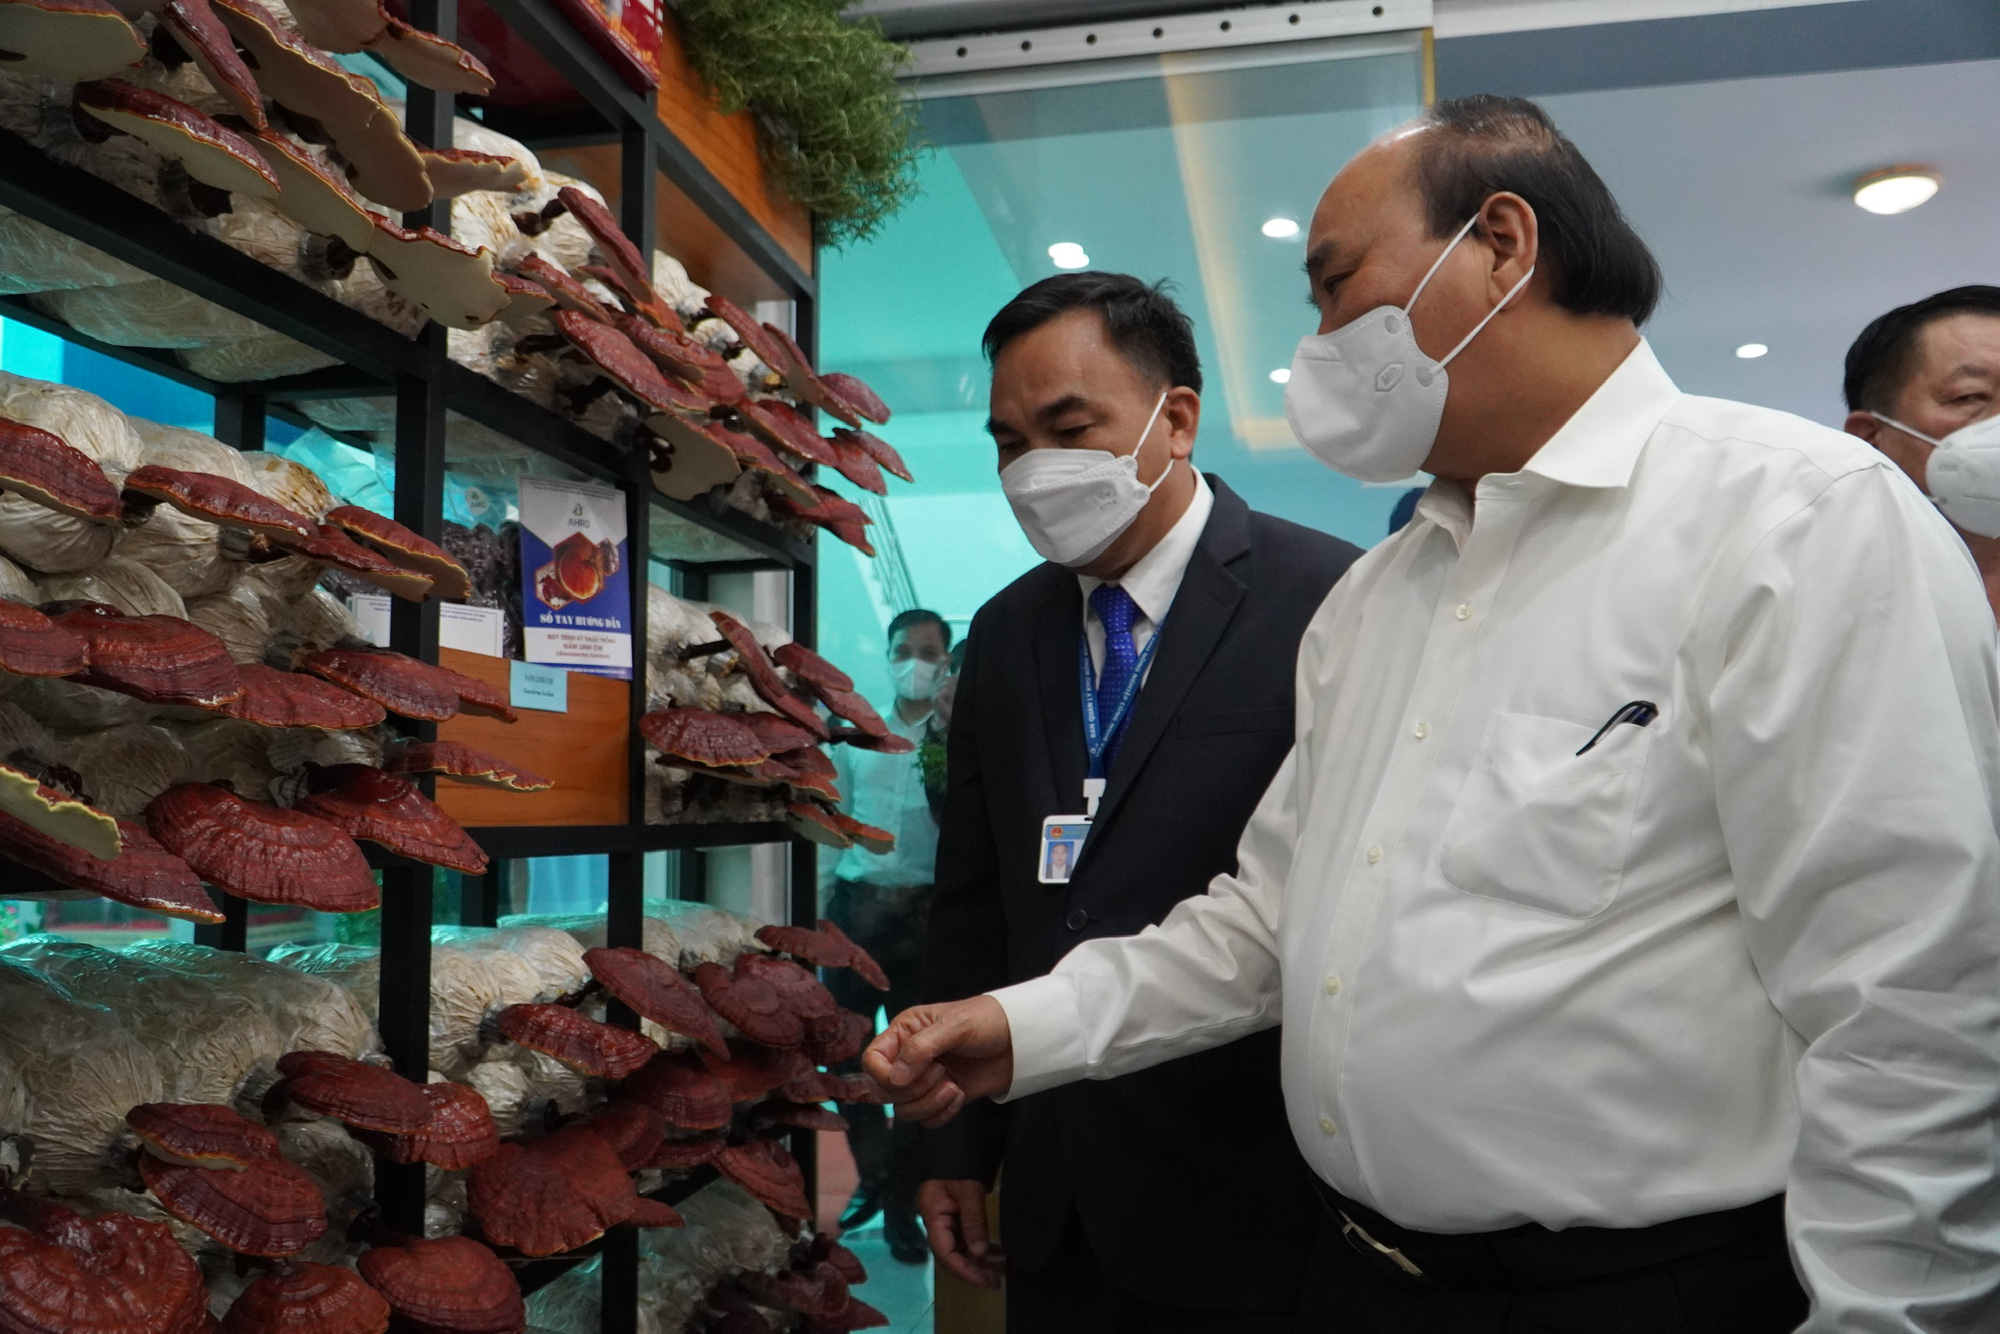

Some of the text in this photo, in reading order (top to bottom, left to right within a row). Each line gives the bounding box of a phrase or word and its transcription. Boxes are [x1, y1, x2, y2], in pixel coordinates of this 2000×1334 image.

[568, 518, 590, 529] AHRD
[539, 610, 554, 624] SỔ
[555, 614, 574, 625] TAY
[1085, 692, 1093, 702] LÝ
[1113, 701, 1125, 722] CÔNG
